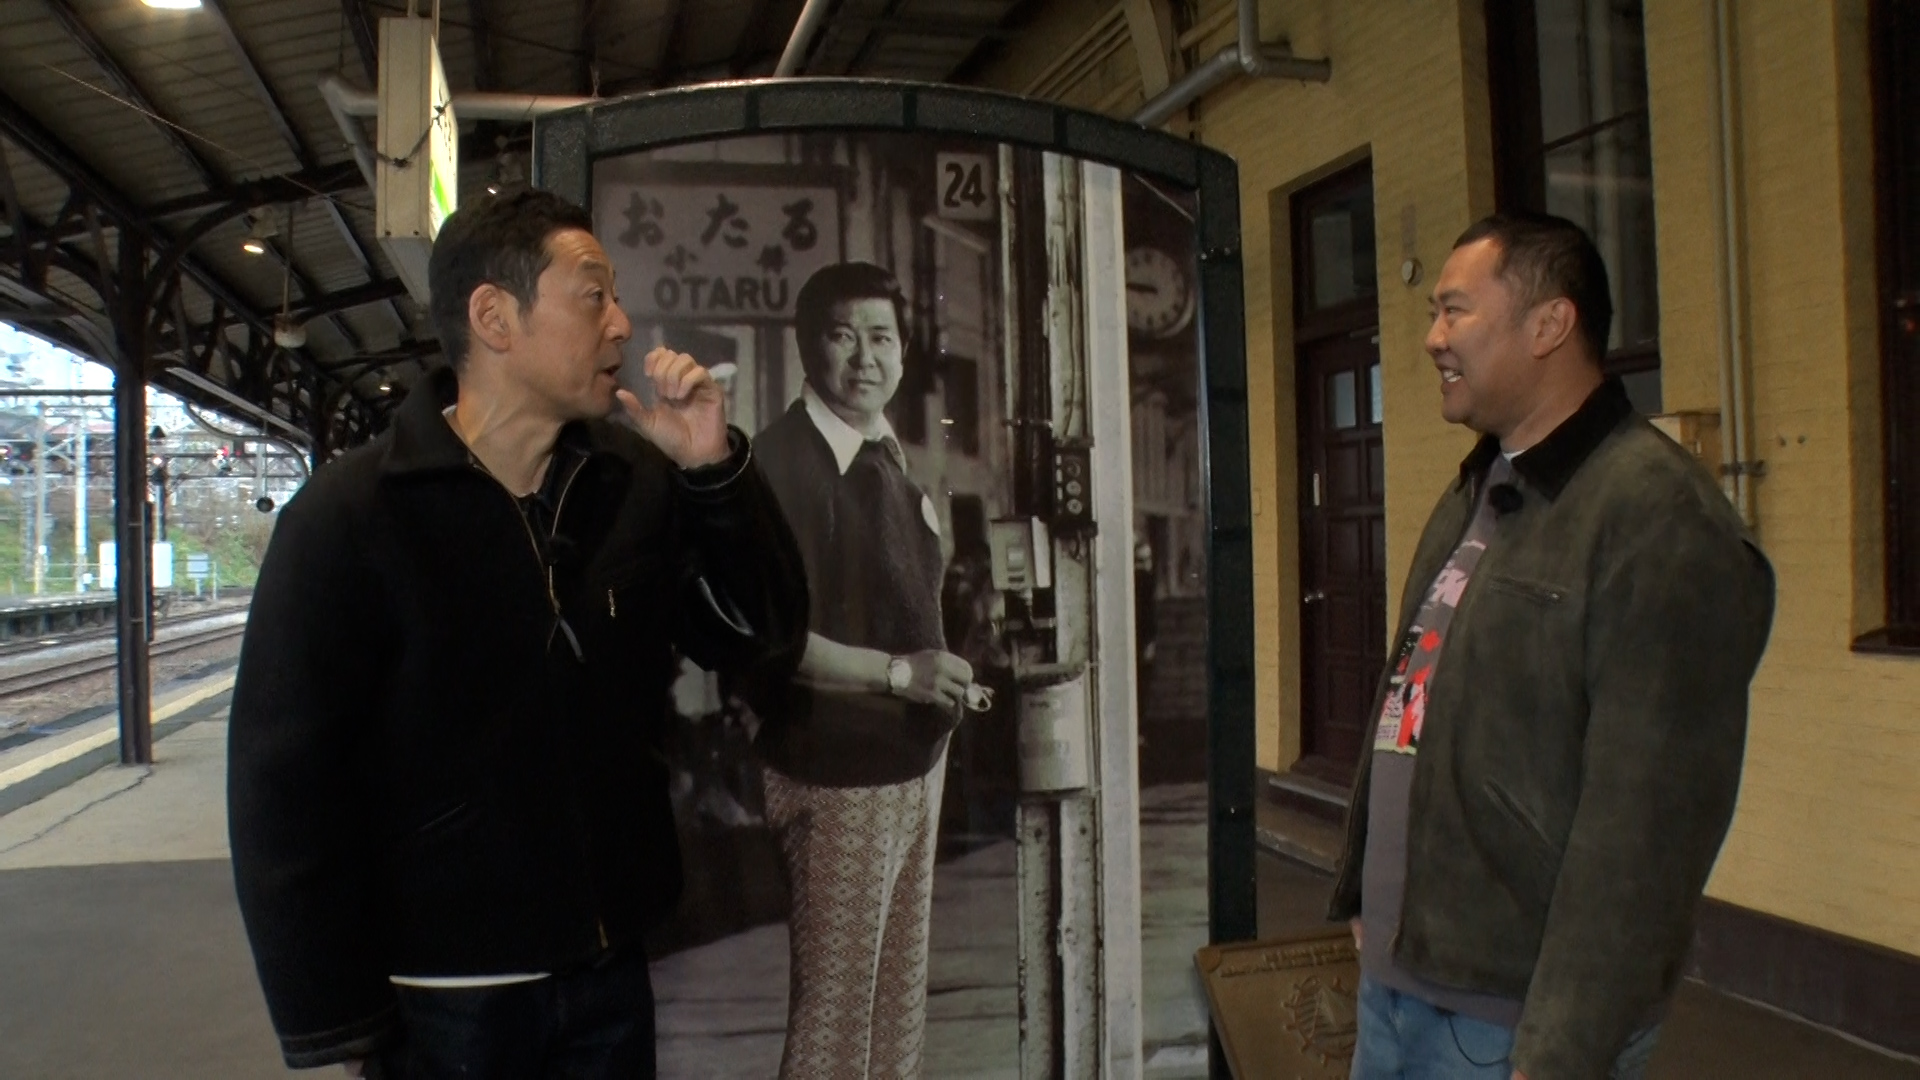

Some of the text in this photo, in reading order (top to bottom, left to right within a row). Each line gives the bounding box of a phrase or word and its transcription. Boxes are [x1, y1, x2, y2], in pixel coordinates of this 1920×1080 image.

[943, 163, 986, 208] 24
[618, 191, 817, 251] おたる
[653, 275, 789, 311] OTARU
